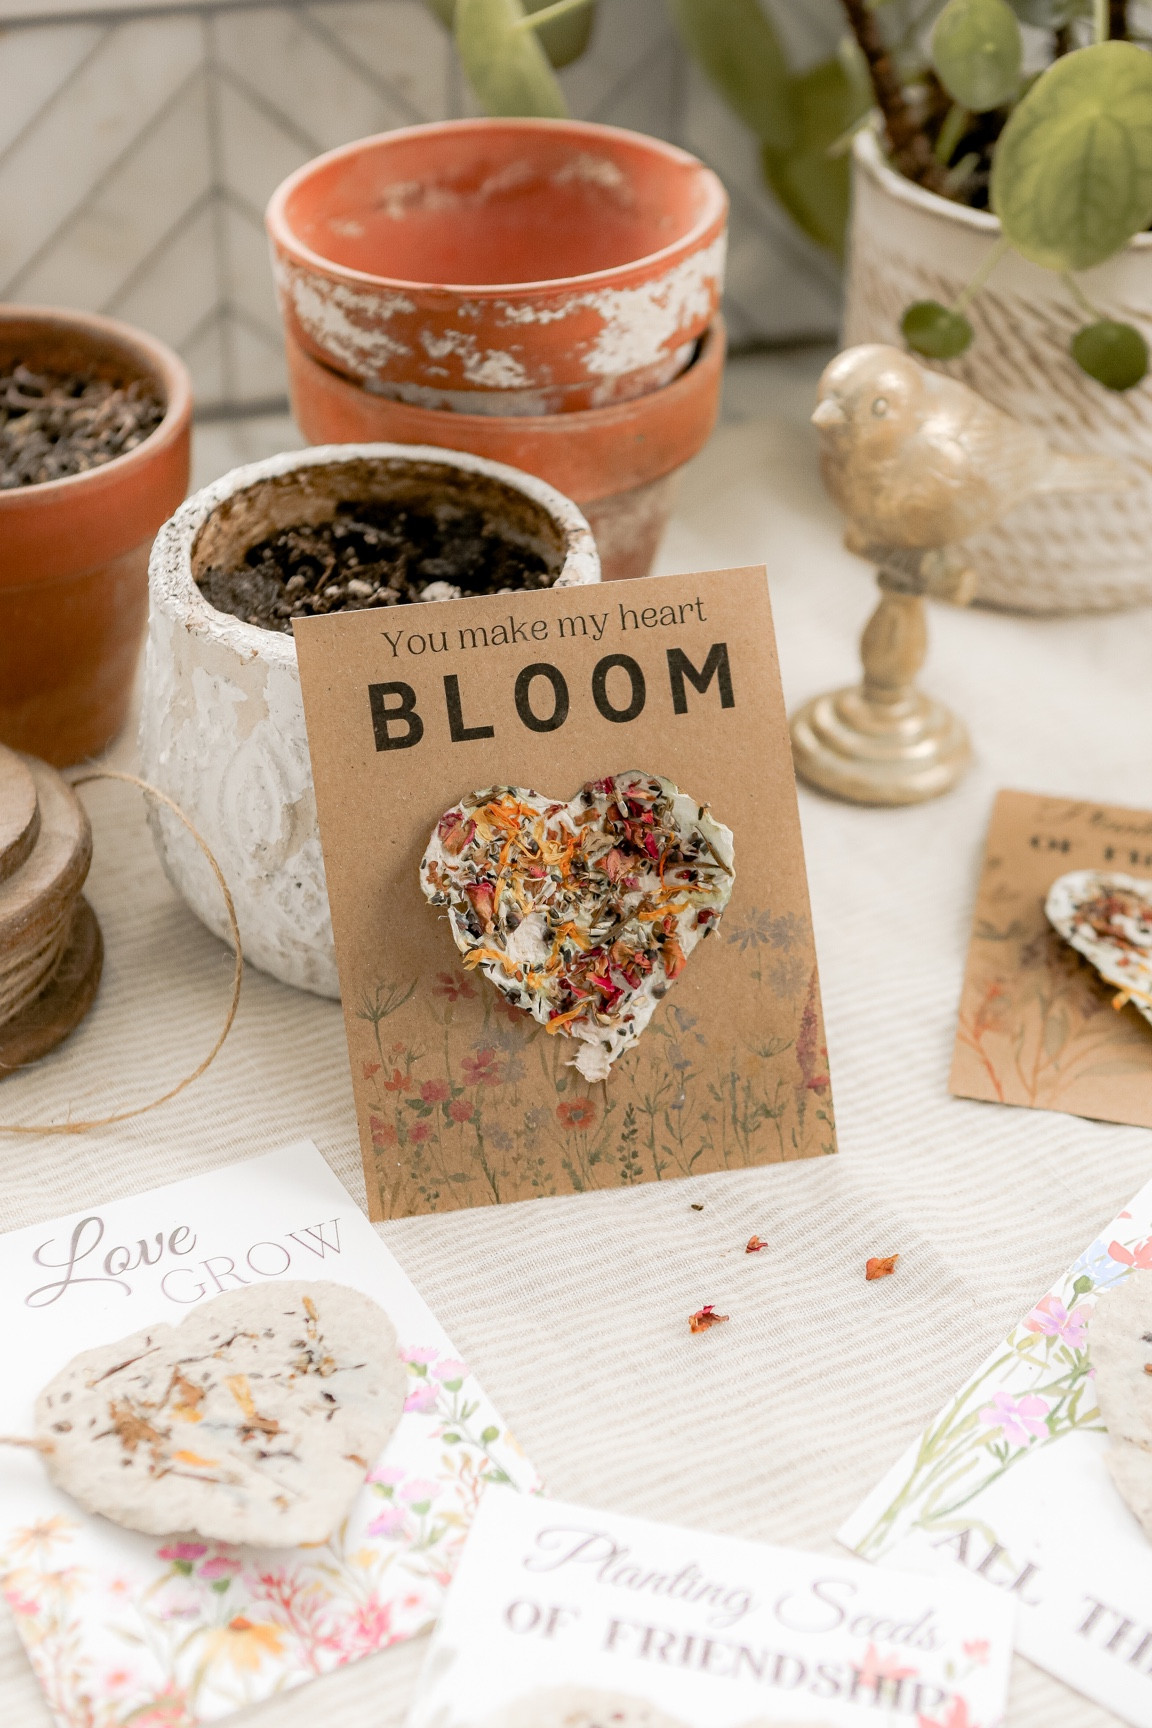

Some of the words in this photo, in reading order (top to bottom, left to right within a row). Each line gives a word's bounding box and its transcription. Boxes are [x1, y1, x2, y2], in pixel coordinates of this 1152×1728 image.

[381, 629, 450, 658] You
[458, 615, 549, 650] make
[557, 611, 609, 641] my
[618, 596, 707, 631] heart
[367, 641, 736, 753] BLOOM
[24, 1215, 198, 1308] Love
[160, 1217, 342, 1304] GROW
[522, 1523, 758, 1629] Planting
[774, 1576, 944, 1653] Seeds
[930, 1527, 1042, 1607] ALL
[502, 1597, 580, 1640] OF
[600, 1616, 951, 1716] FRIENDSHIP
